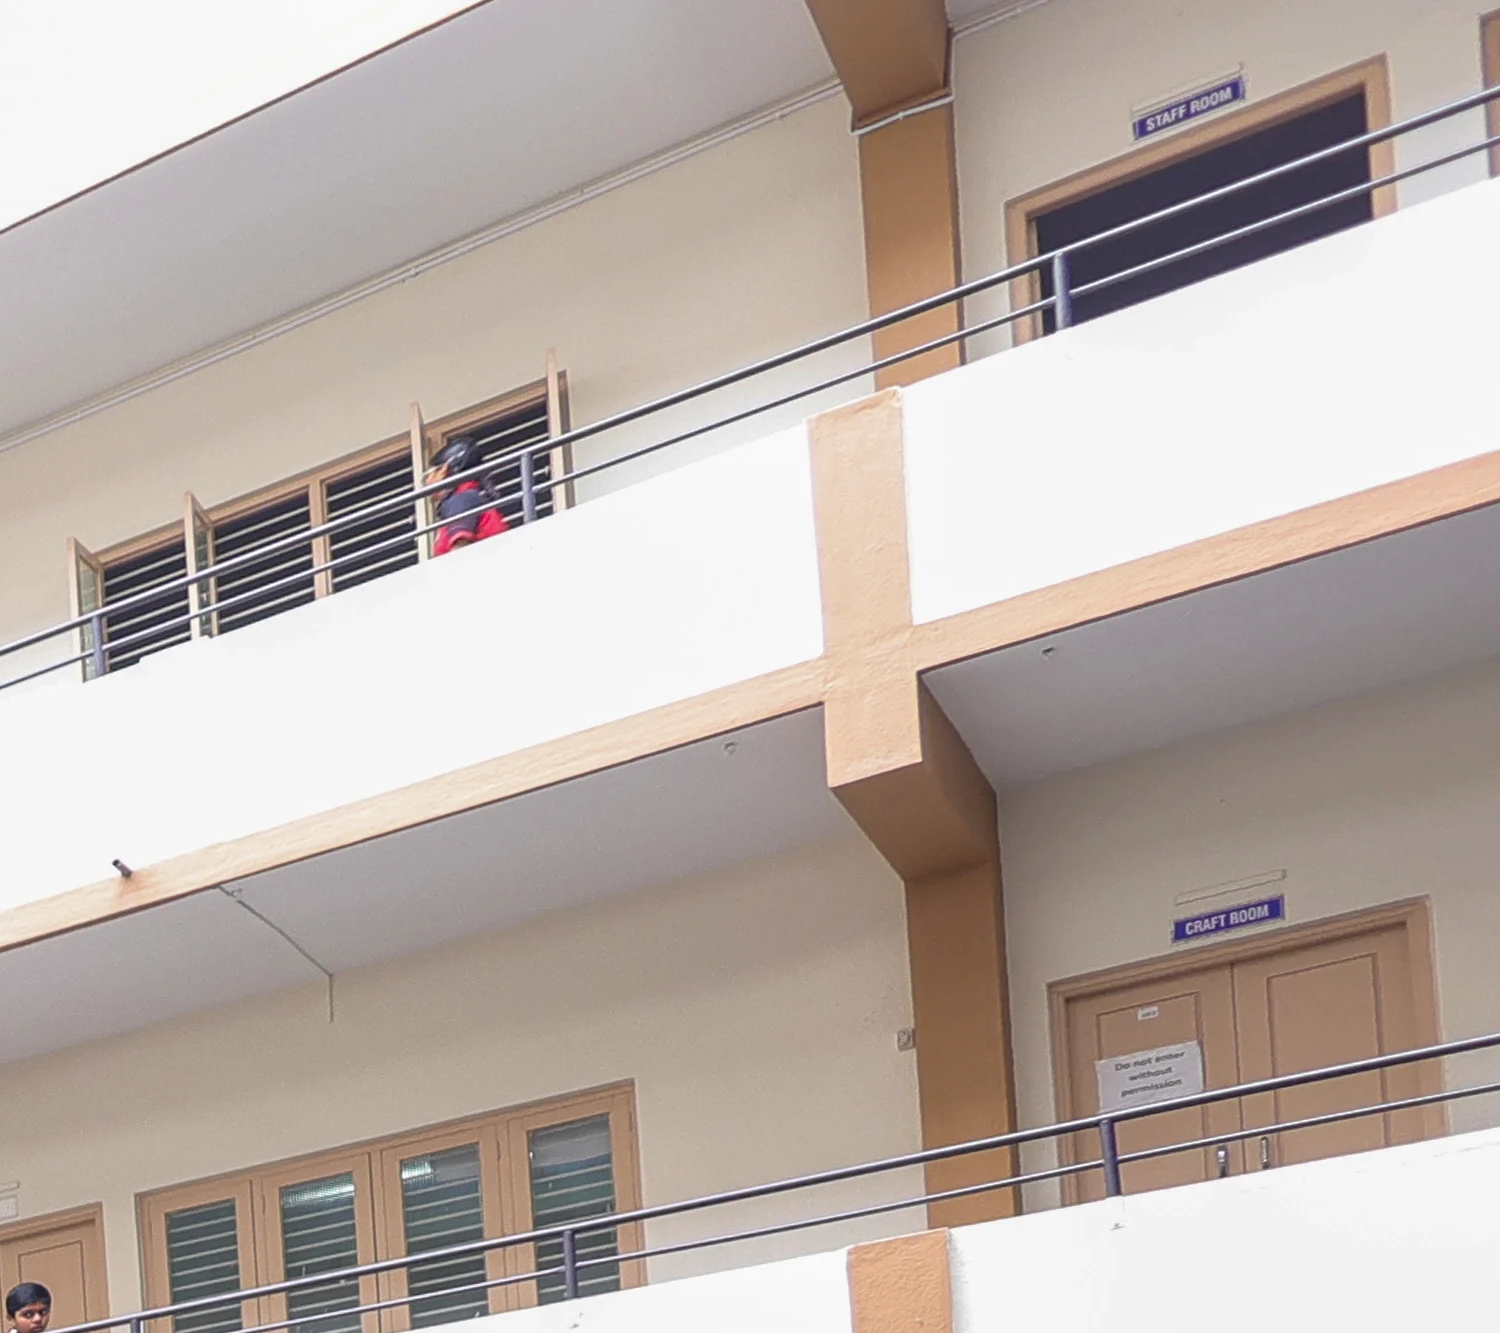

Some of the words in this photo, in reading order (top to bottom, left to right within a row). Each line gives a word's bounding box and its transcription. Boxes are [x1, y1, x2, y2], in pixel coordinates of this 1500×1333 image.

[1145, 105, 1189, 132] STAFF
[1190, 86, 1233, 116] ROOM
[1184, 913, 1225, 936] CRAFT
[1228, 904, 1269, 926] ROOM
[1114, 1062, 1127, 1071] Do
[1120, 1078, 1182, 1098] permission
